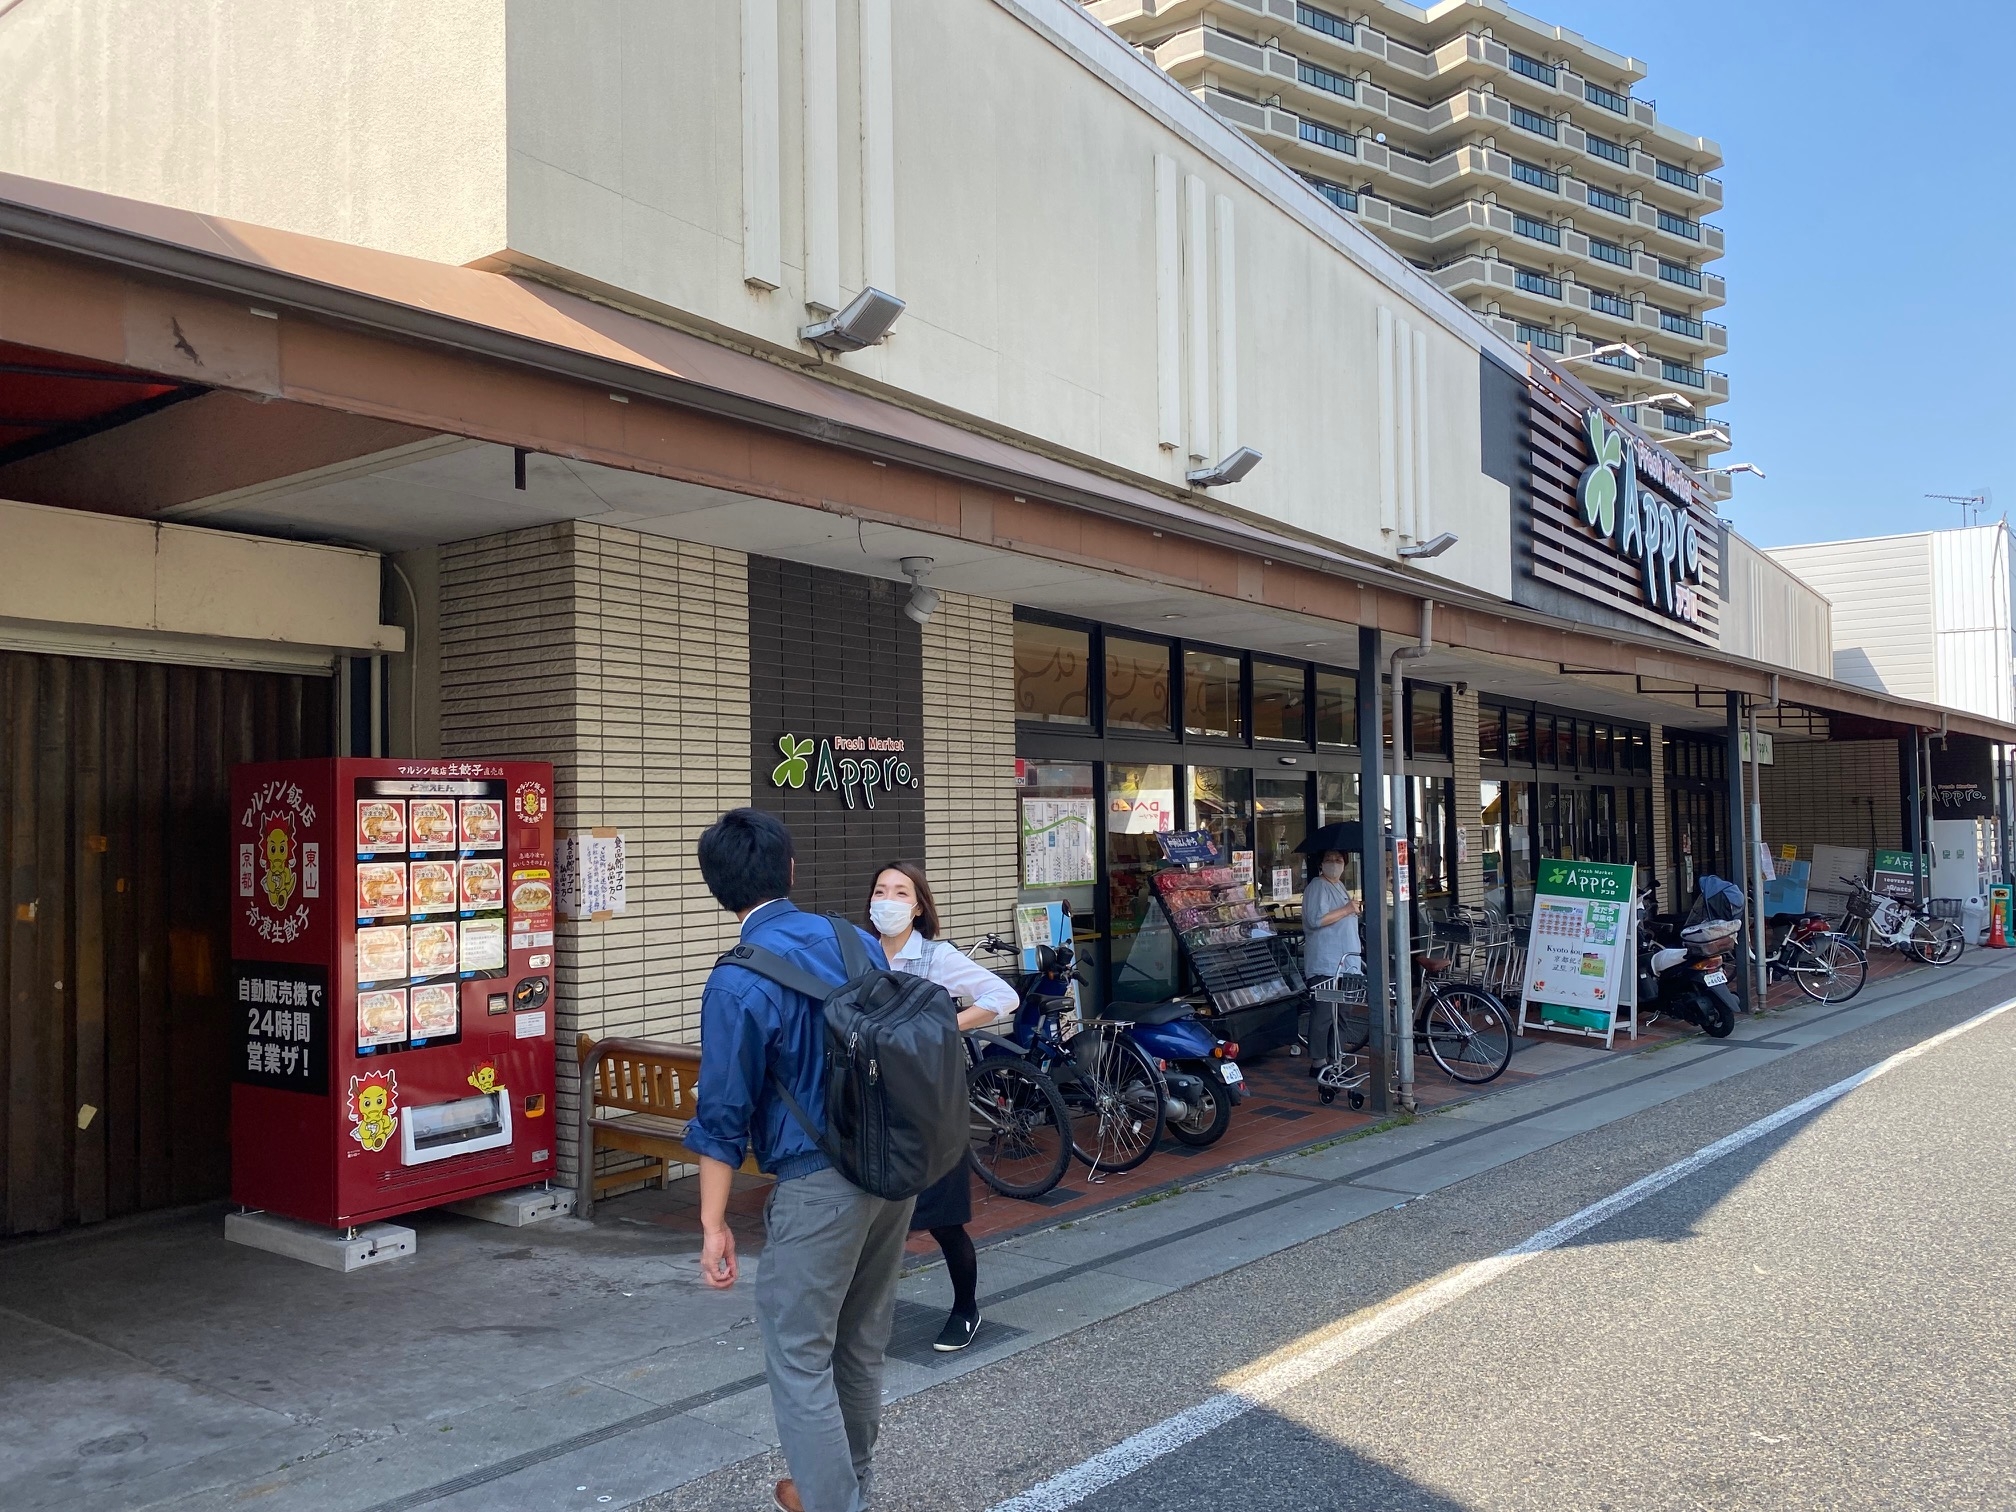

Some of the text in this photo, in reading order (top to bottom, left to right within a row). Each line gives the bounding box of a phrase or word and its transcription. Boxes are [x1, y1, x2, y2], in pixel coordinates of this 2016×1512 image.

[835, 735, 905, 752] Fresh Market
[814, 738, 919, 810] Appro.
[241, 779, 317, 828] マルシン飯店
[241, 849, 253, 891] 京都
[304, 848, 318, 891] 東山
[1566, 870, 1619, 894] Appro.
[245, 901, 310, 944] 冷凍生餃子
[1593, 906, 1615, 915] 友だち
[1547, 945, 1569, 954] Kyoto
[238, 977, 322, 1007] 自動販売機で
[248, 1008, 311, 1042] 24時間
